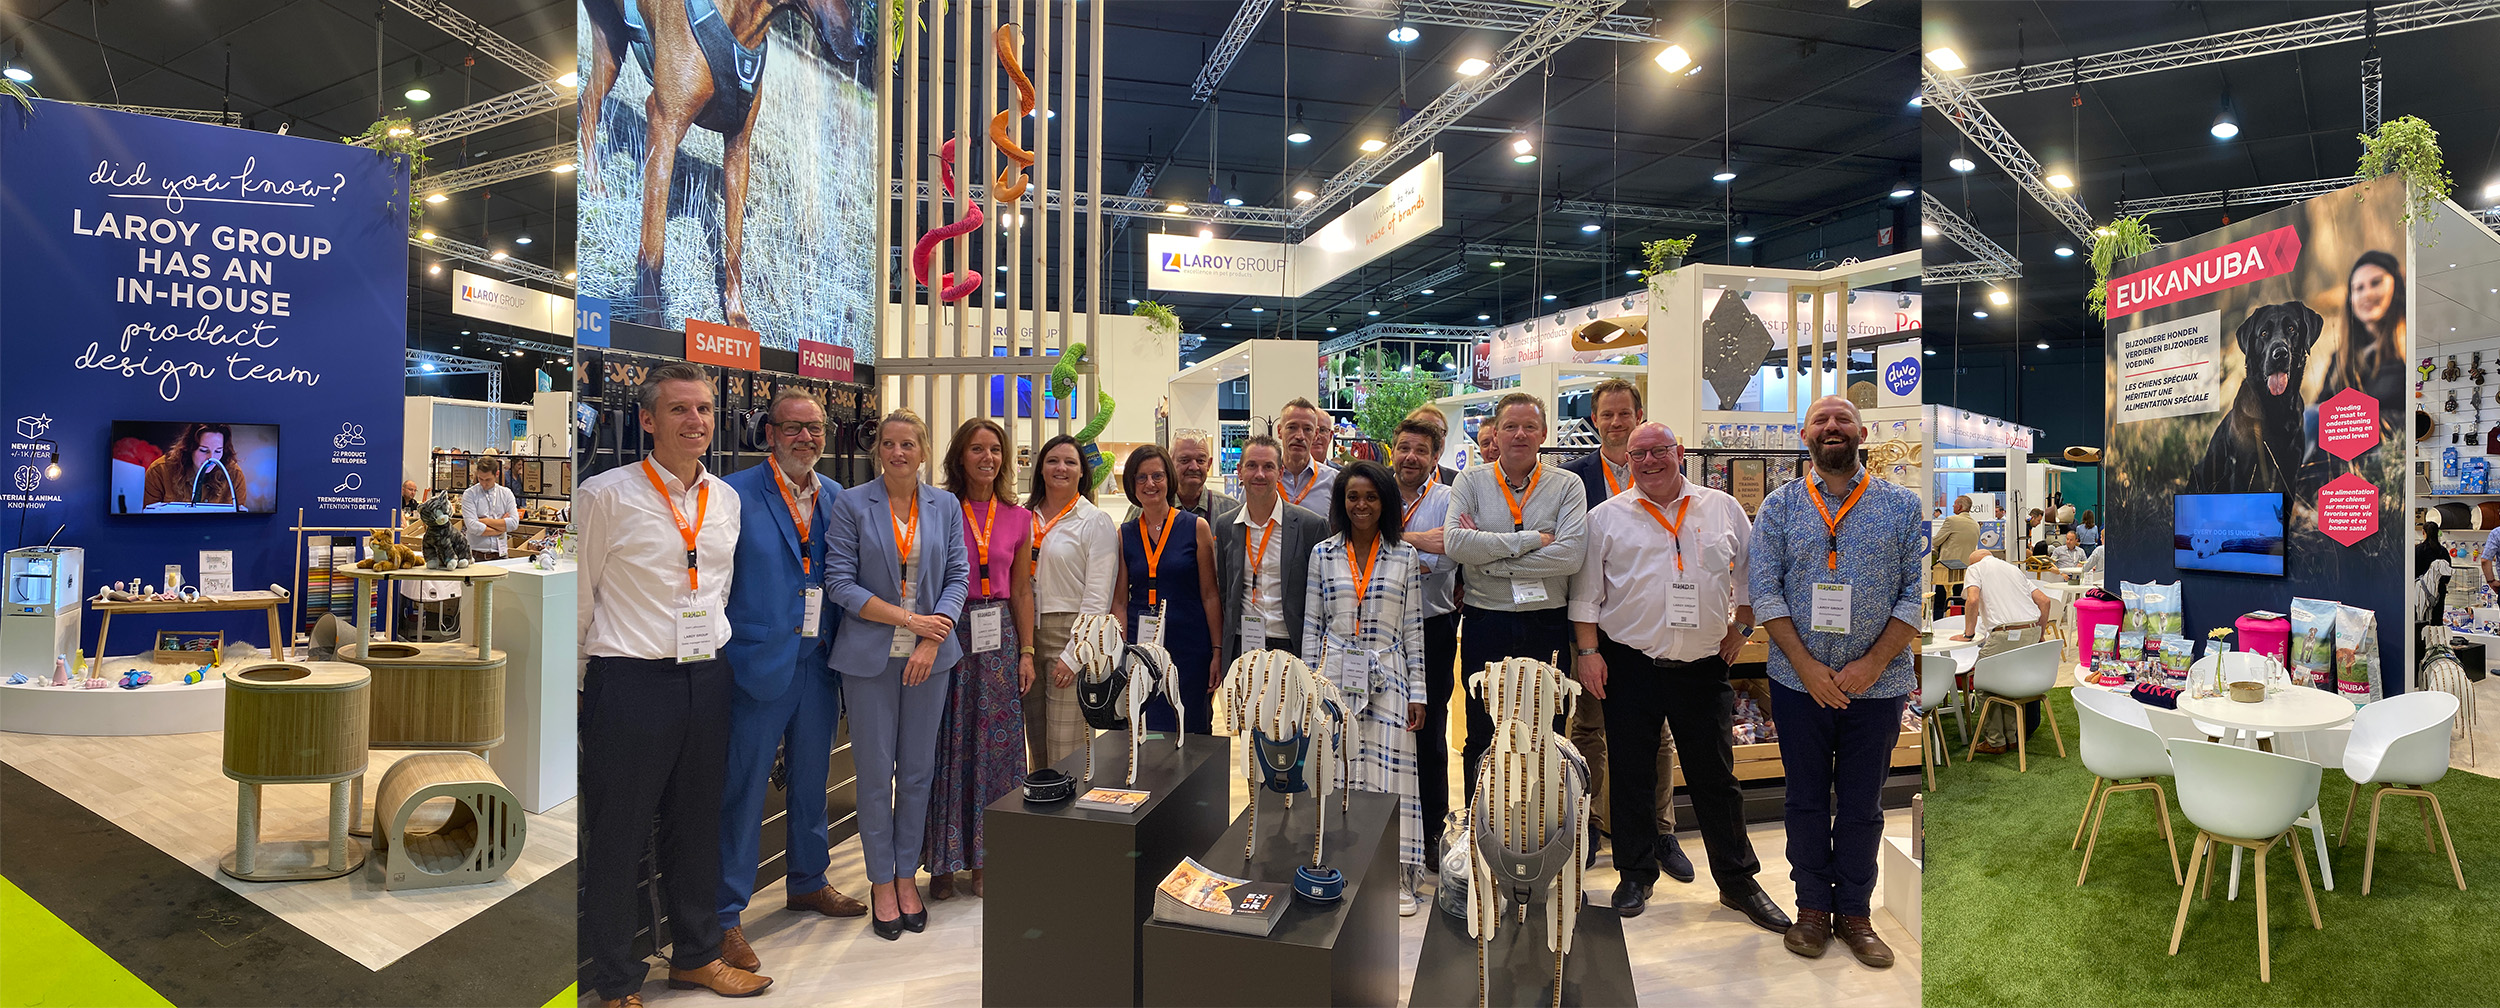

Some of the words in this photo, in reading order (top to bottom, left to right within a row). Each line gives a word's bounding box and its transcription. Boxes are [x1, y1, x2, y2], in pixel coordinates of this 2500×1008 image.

[89, 160, 151, 187] did
[162, 173, 230, 214] you
[230, 156, 346, 202] know?
[1373, 201, 1396, 221] Welcome
[1397, 193, 1403, 203] to
[1365, 226, 1385, 246] house
[1388, 212, 1396, 235] of
[1398, 194, 1425, 223] brands
[73, 208, 200, 247] LAROY
[211, 225, 332, 261] GROUP
[138, 247, 211, 279] HAS
[222, 257, 272, 285] AN
[1183, 253, 1233, 270] LAROY
[1236, 256, 1286, 273] GROUP
[2116, 245, 2265, 309] EUKANUBA
[116, 277, 291, 317] IN-HOUSE
[473, 287, 499, 302] LAROY
[499, 293, 526, 309] GROUP
[120, 314, 279, 352] product
[1021, 327, 1058, 339] GRUP
[1762, 319, 1778, 331] est
[1781, 320, 1803, 335] pt
[1858, 321, 1887, 335] from
[695, 332, 752, 359] SAFETY
[1503, 340, 1513, 350] The
[1513, 337, 1530, 349] finest
[1529, 333, 1540, 345] pet
[1541, 328, 1568, 342] products
[2125, 333, 2166, 350] BIJZONDERE
[2167, 326, 2199, 340] HONDEN
[2125, 345, 2163, 359] VERDIENEN
[2163, 335, 2209, 352] BIJZONDERE
[802, 350, 851, 373] FASHION
[1502, 356, 1516, 365] from
[1518, 345, 1544, 363] Poland
[2125, 357, 2155, 370] VOEDING
[74, 341, 215, 401] design
[226, 352, 320, 386] team
[1888, 364, 1916, 382] duvo
[1893, 378, 1914, 392] plus
[2124, 382, 2137, 392] LES
[2137, 378, 2162, 390] CHIENS
[2163, 372, 2199, 385] SPÉCIAUX
[2124, 389, 2158, 402] MÉRITENT
[2158, 387, 2173, 397] UNE
[2124, 398, 2173, 412] ALIMENTATION
[2174, 392, 2209, 405] SPÉCIALE
[2335, 404, 2361, 412] Voeding
[2326, 418, 2371, 427] ondersteuning
[29, 443, 51, 451] ITEMS
[2005, 432, 2028, 449] Poland
[2327, 433, 2350, 442] gezond
[331, 457, 367, 465] DEVELOPERS
[2193, 528, 2212, 536] EVERY
